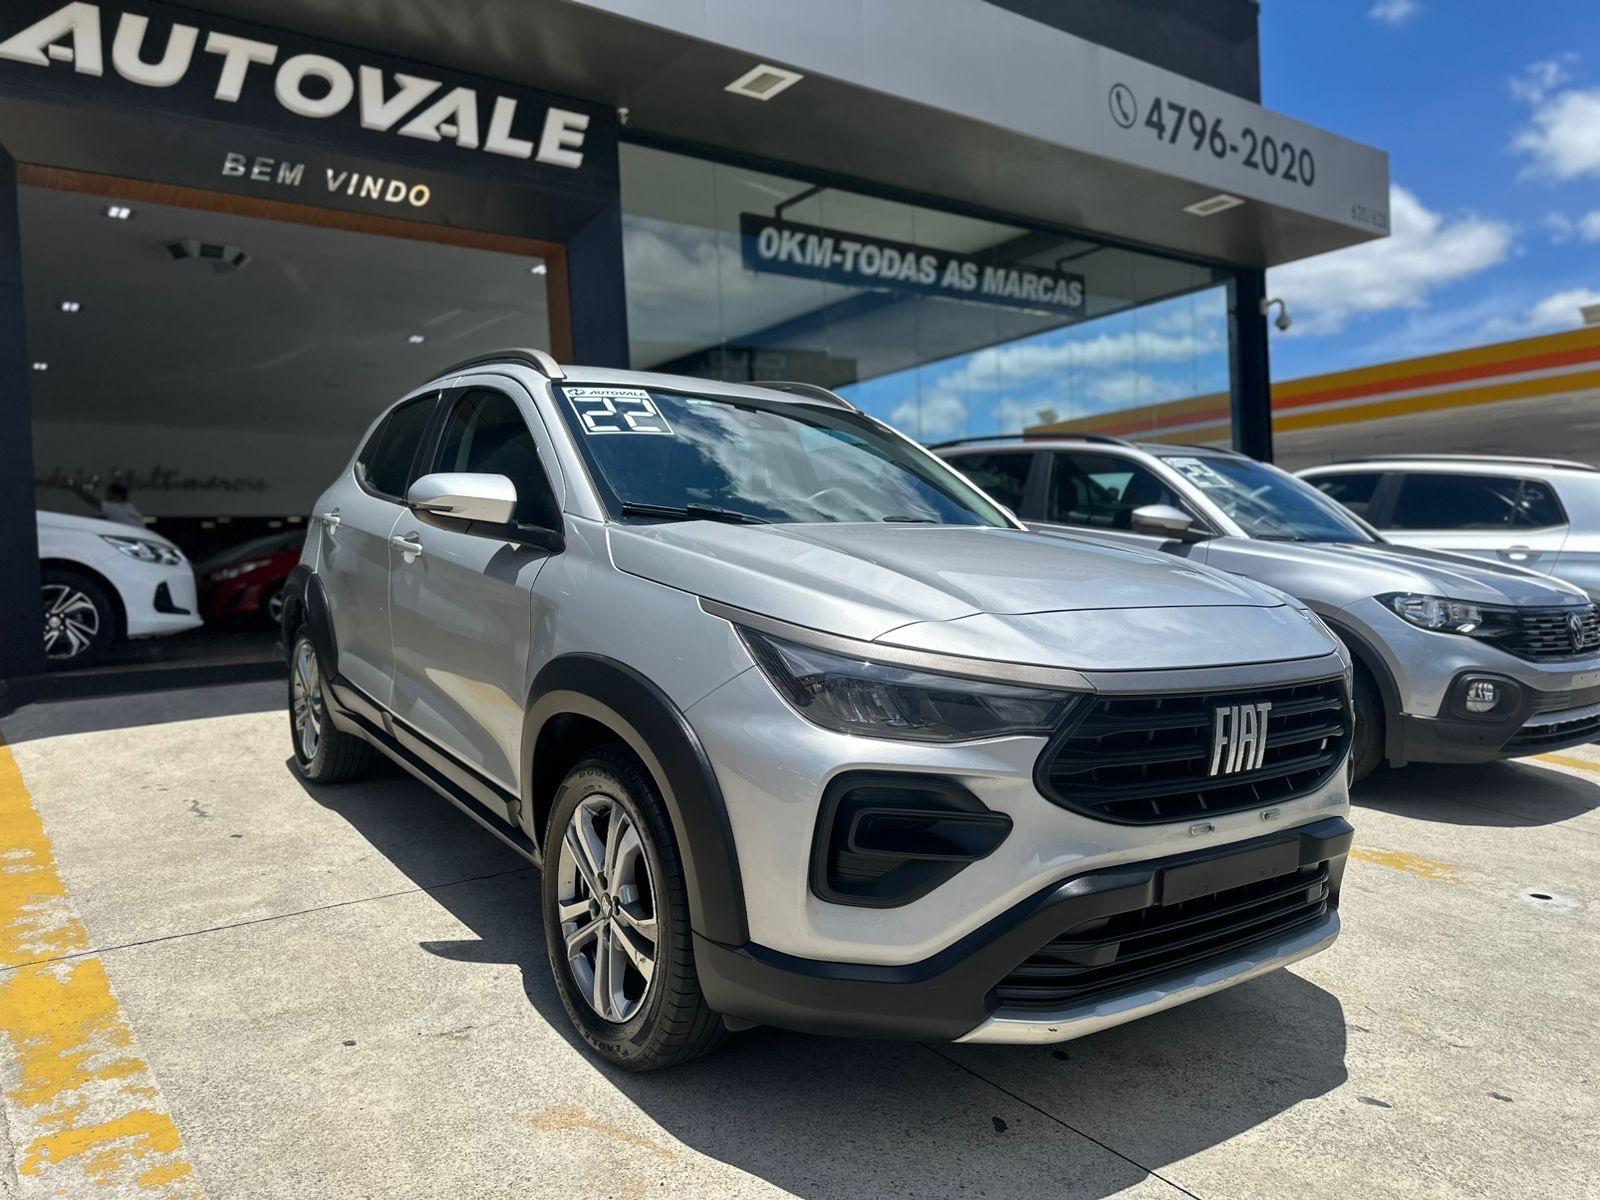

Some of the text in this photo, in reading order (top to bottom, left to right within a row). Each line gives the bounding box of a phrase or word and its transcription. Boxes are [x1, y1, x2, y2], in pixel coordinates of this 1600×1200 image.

[0, 1, 591, 169] AUTOVALE
[1144, 97, 1316, 187] 4796-2020
[221, 152, 431, 207] BEM VINDO
[939, 259, 979, 291] AS
[982, 267, 1084, 308] MARCAS
[573, 397, 662, 432] 22
[589, 389, 647, 397] AUTOVALE
[1209, 702, 1272, 776] FIAT
